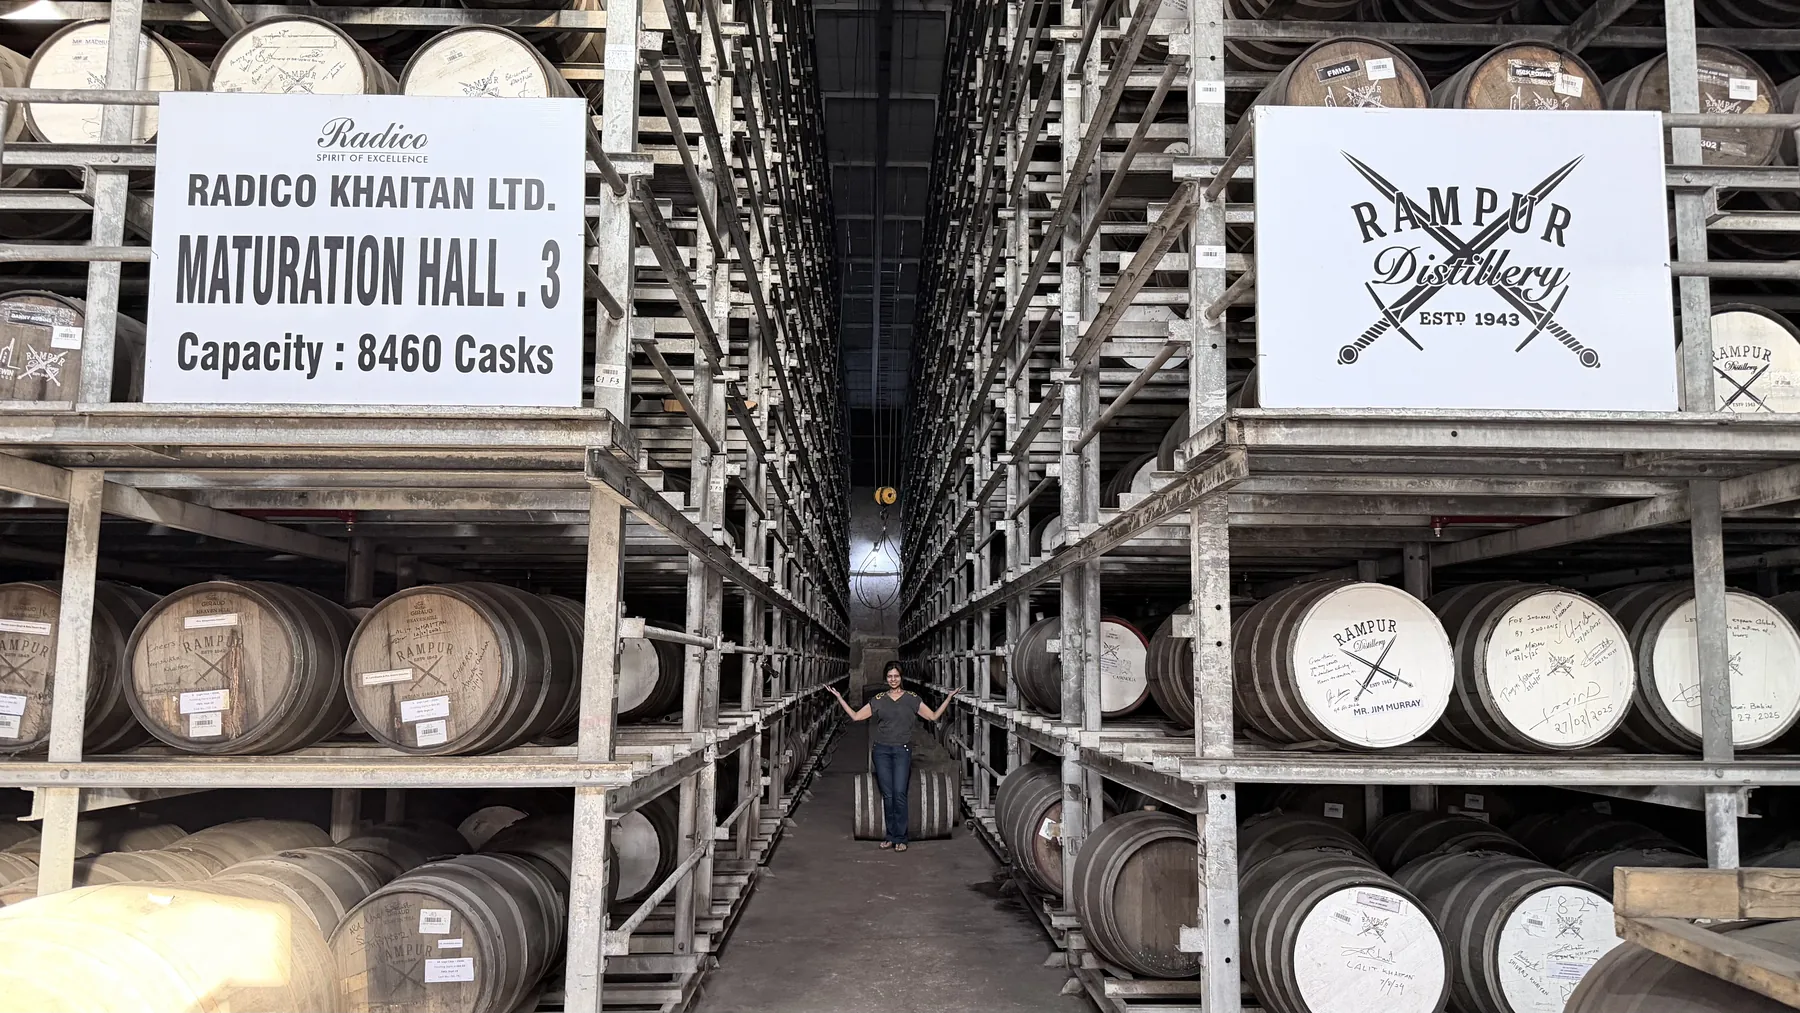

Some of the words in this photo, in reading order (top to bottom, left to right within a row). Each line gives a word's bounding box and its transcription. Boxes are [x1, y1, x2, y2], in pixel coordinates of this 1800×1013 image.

[1326, 65, 1352, 77] FMHG
[1346, 85, 1382, 100] RAMPUR
[1533, 97, 1569, 112] RAMPR
[316, 116, 429, 150] Radico
[316, 153, 347, 163] SPIRIT
[349, 154, 365, 163] OF
[367, 154, 429, 164] EXCELLENCE
[187, 173, 317, 208] RADICO
[330, 174, 475, 210] KHAITAN
[488, 177, 556, 211] LTD.
[1350, 185, 1572, 248] RAMPUR
[176, 234, 405, 306] MATURATION
[417, 237, 505, 307] HALL
[541, 239, 561, 309] 3
[1371, 245, 1571, 302] Distillery
[1475, 312, 1520, 327] 1943
[26, 351, 65, 367] RAMPUR
[177, 330, 323, 379] Capacity
[358, 333, 442, 374] 8460
[454, 334, 554, 375] Casks
[1711, 345, 1772, 362] RAMPUR
[1724, 361, 1758, 375] Distillery
[1333, 619, 1397, 647] RAMPUR
[0, 638, 49, 658] AMPUR
[183, 634, 244, 654] RAMPUR
[396, 641, 454, 662] RAMPUR
[1353, 639, 1386, 653] Distillery
[1353, 707, 1370, 716] MR.
[1371, 704, 1385, 714] JIM
[1386, 699, 1421, 712] MURRAY
[1555, 704, 1613, 734] 27/02/2025
[384, 944, 433, 962] AMPUR
[1346, 961, 1378, 972] LALIT
